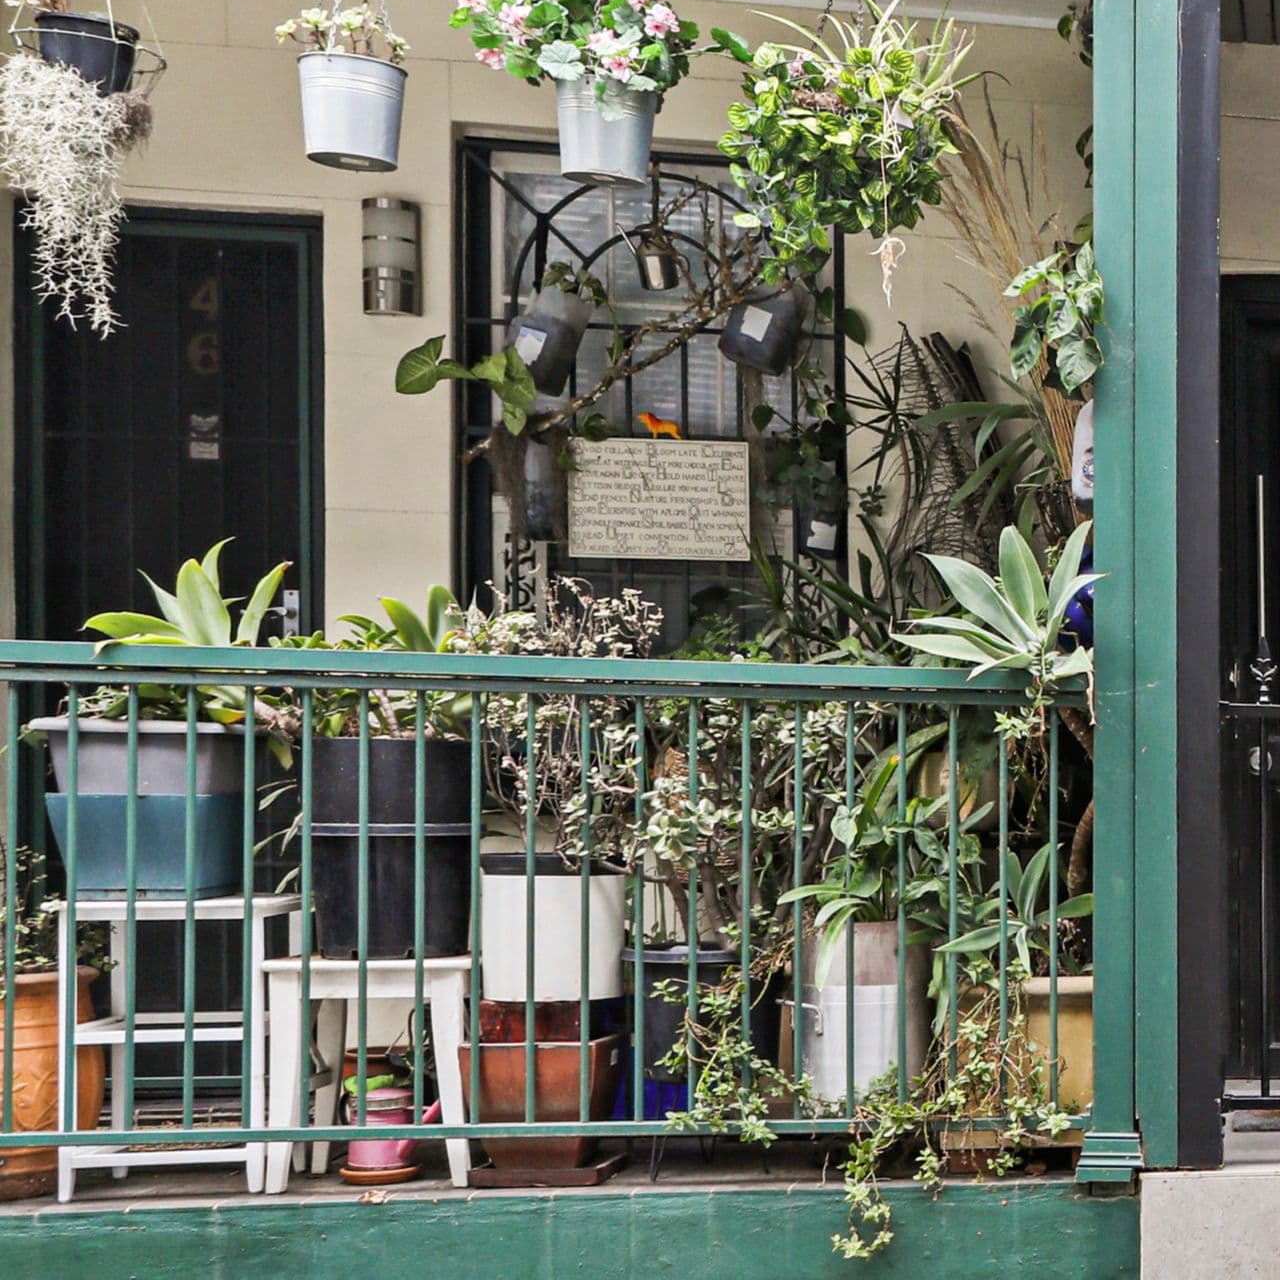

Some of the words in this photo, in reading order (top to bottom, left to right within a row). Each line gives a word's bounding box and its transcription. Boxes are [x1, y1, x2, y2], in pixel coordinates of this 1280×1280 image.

[678, 449, 697, 457] LATE
[656, 468, 680, 481] HOLD
[682, 474, 706, 482] HANDS
[639, 533, 689, 541] CONVENTION
